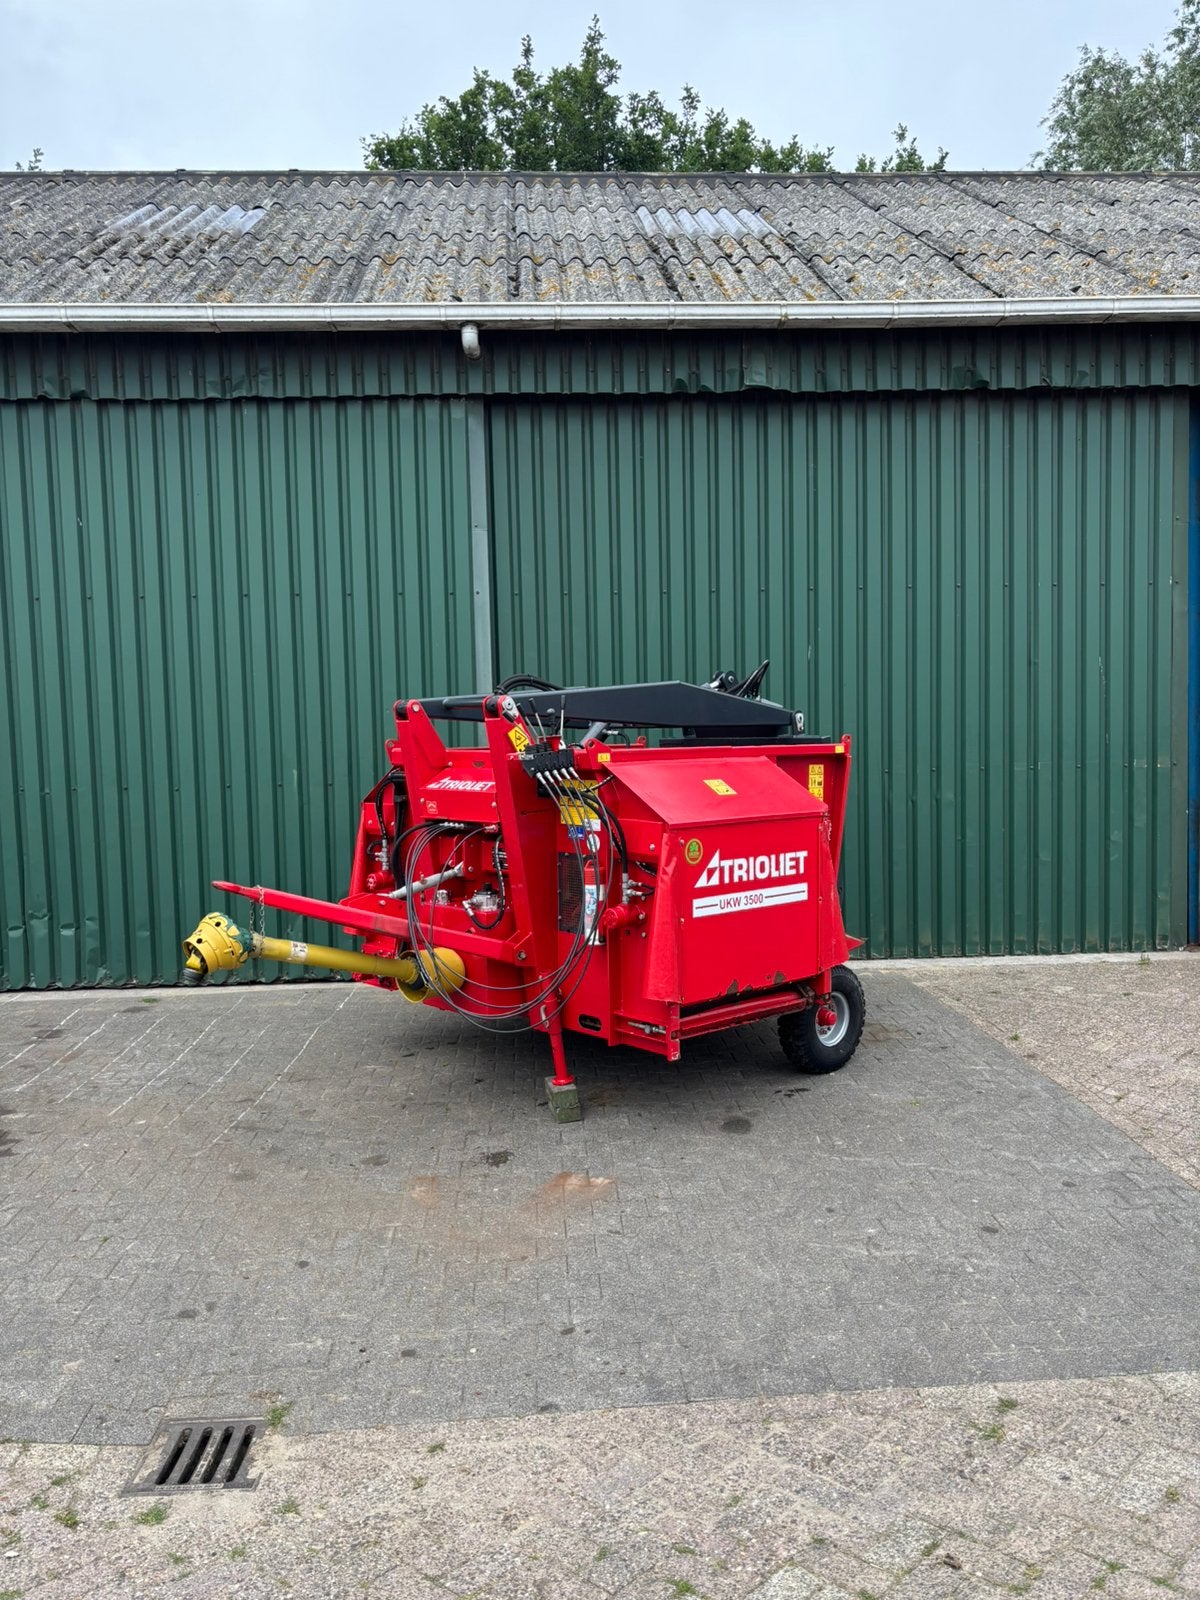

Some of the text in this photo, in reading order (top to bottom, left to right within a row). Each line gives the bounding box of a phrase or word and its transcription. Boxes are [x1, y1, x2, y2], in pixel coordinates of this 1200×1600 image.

[440, 780, 496, 791] TRIOLIET
[720, 850, 808, 884] TRIOLIET
[719, 893, 764, 910] UKW 3500
